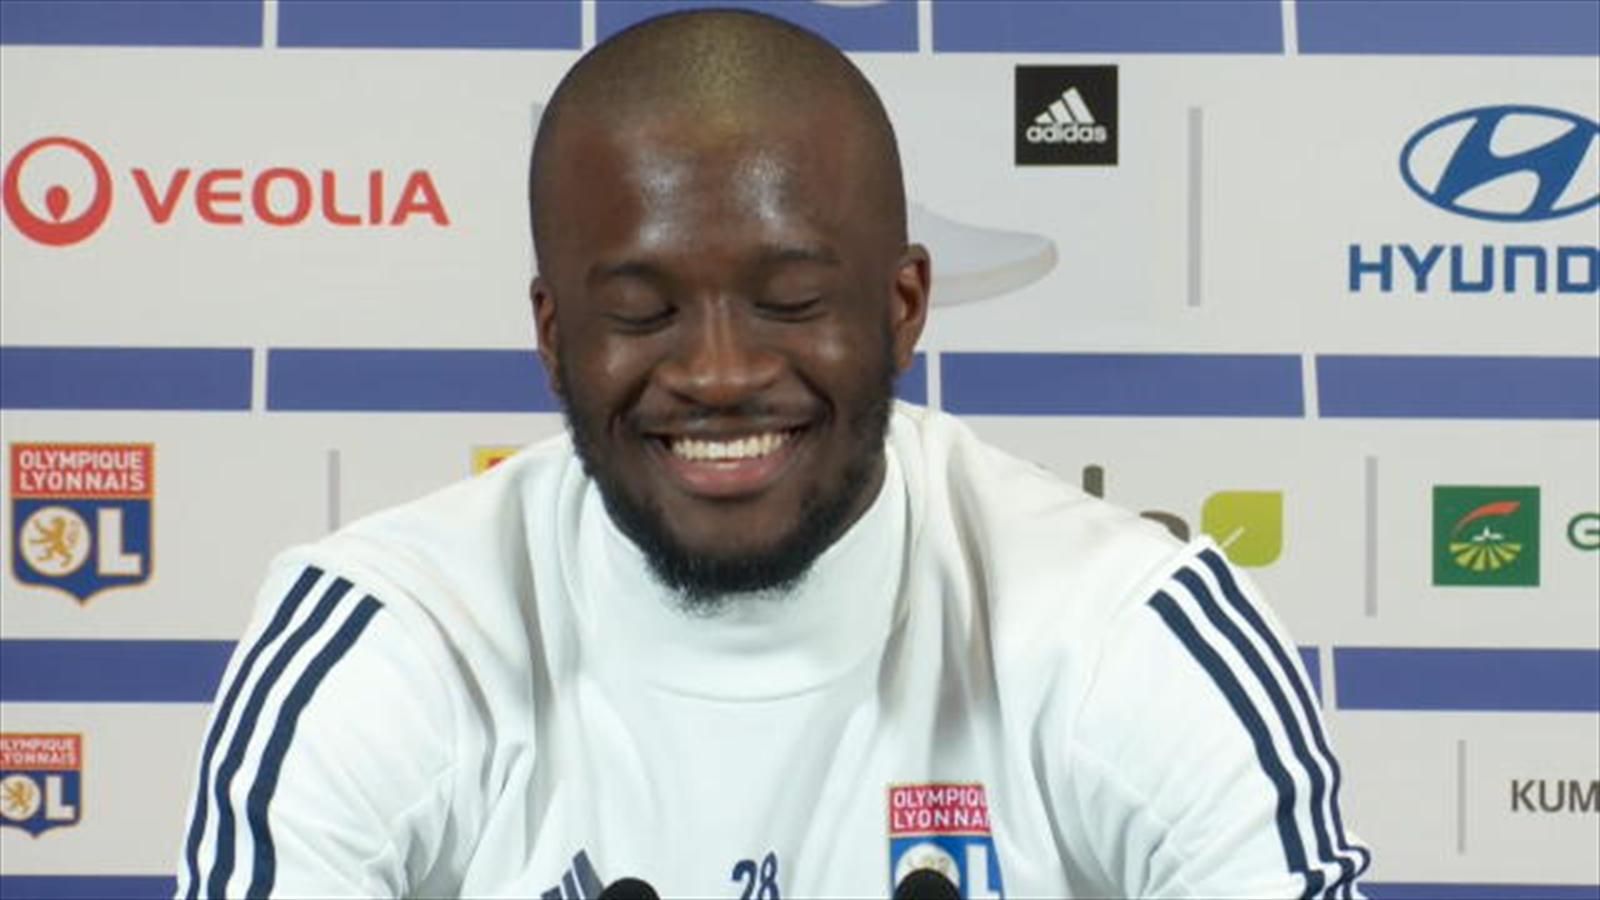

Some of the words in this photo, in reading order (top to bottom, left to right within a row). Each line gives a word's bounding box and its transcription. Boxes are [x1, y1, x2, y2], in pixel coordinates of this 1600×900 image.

[1025, 121, 1107, 144] adidas
[131, 167, 450, 227] VEOLIA
[19, 450, 144, 471] OLYMPIQUE
[19, 471, 145, 492] LYONNAIS
[20, 506, 142, 577] OL
[0, 752, 76, 767] YONNAIS
[1511, 779, 1600, 812] KUM
[732, 850, 780, 900] 28
